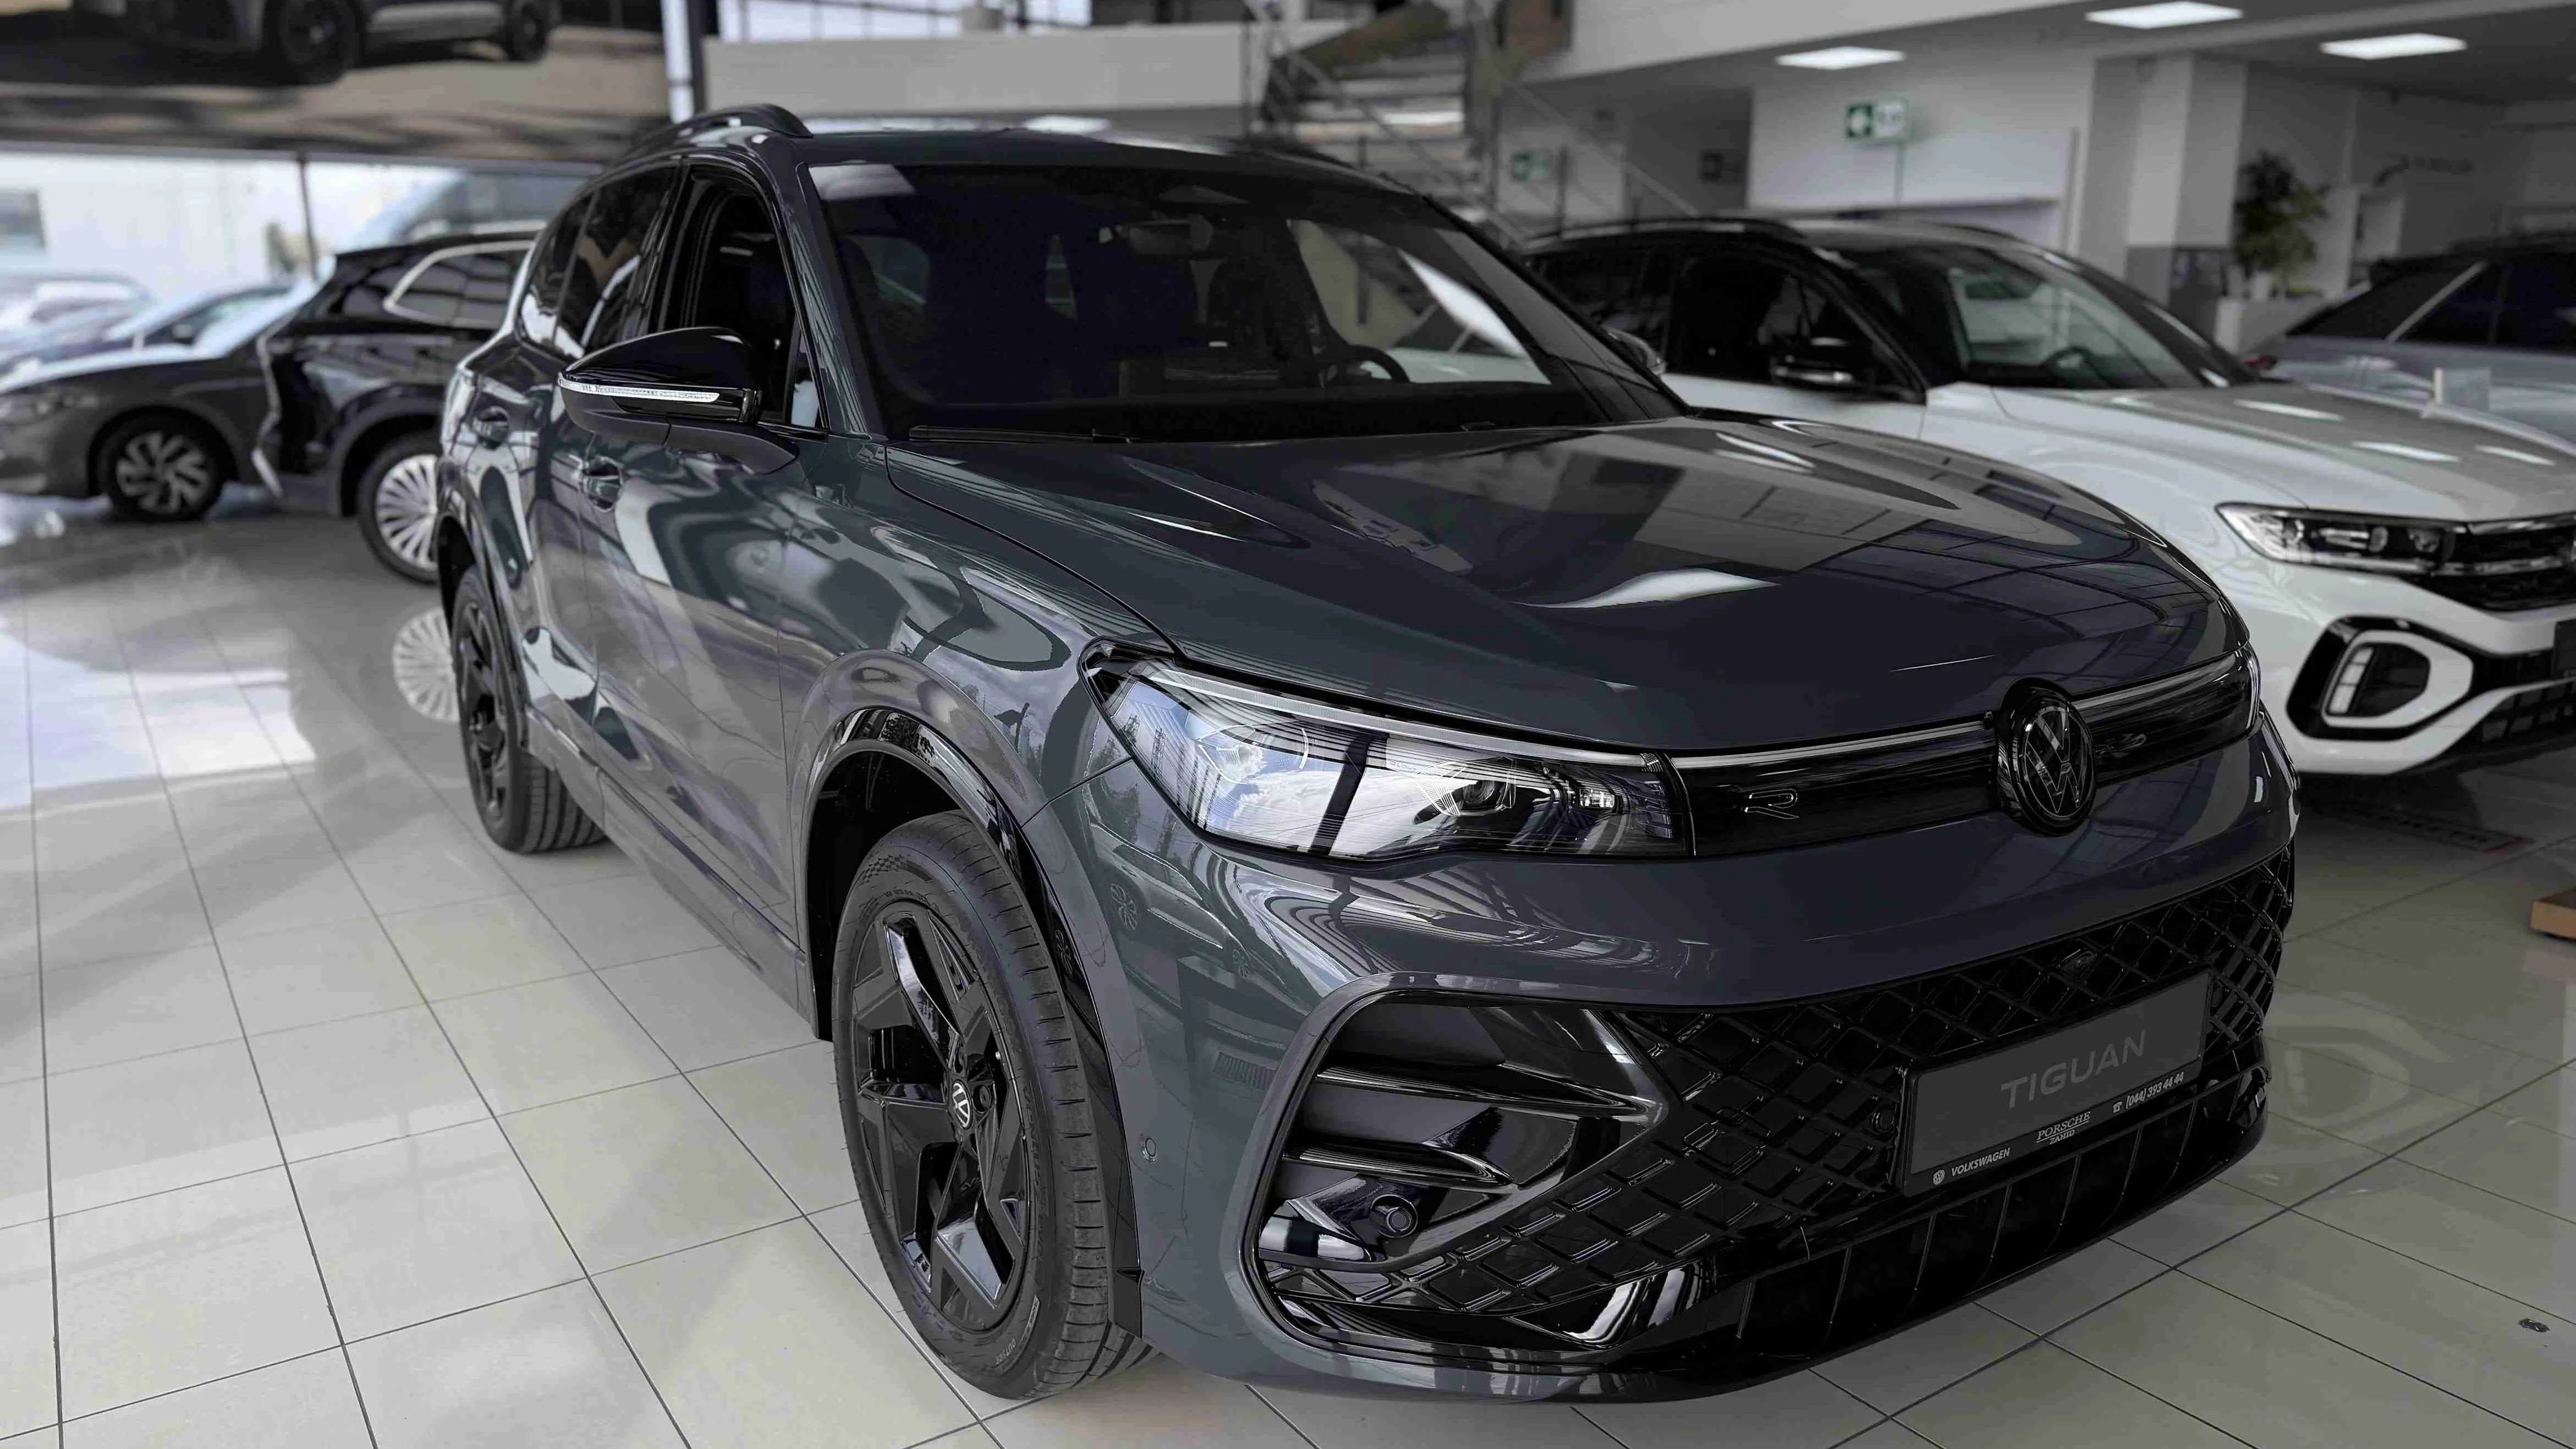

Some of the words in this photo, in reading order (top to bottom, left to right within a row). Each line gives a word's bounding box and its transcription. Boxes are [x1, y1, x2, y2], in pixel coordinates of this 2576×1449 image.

[1740, 788, 1800, 820] R
[2001, 1029, 2146, 1109] TIGUAN
[2125, 1088, 2147, 1110] (044)
[2147, 1082, 2162, 1097] 393
[2163, 1076, 2174, 1089] 44
[2173, 1071, 2184, 1084] 44
[2036, 1111, 2090, 1140] PORSCHE
[2049, 1129, 2075, 1145] ZAHID
[1951, 1148, 2011, 1177] VOLKSWAGEN
